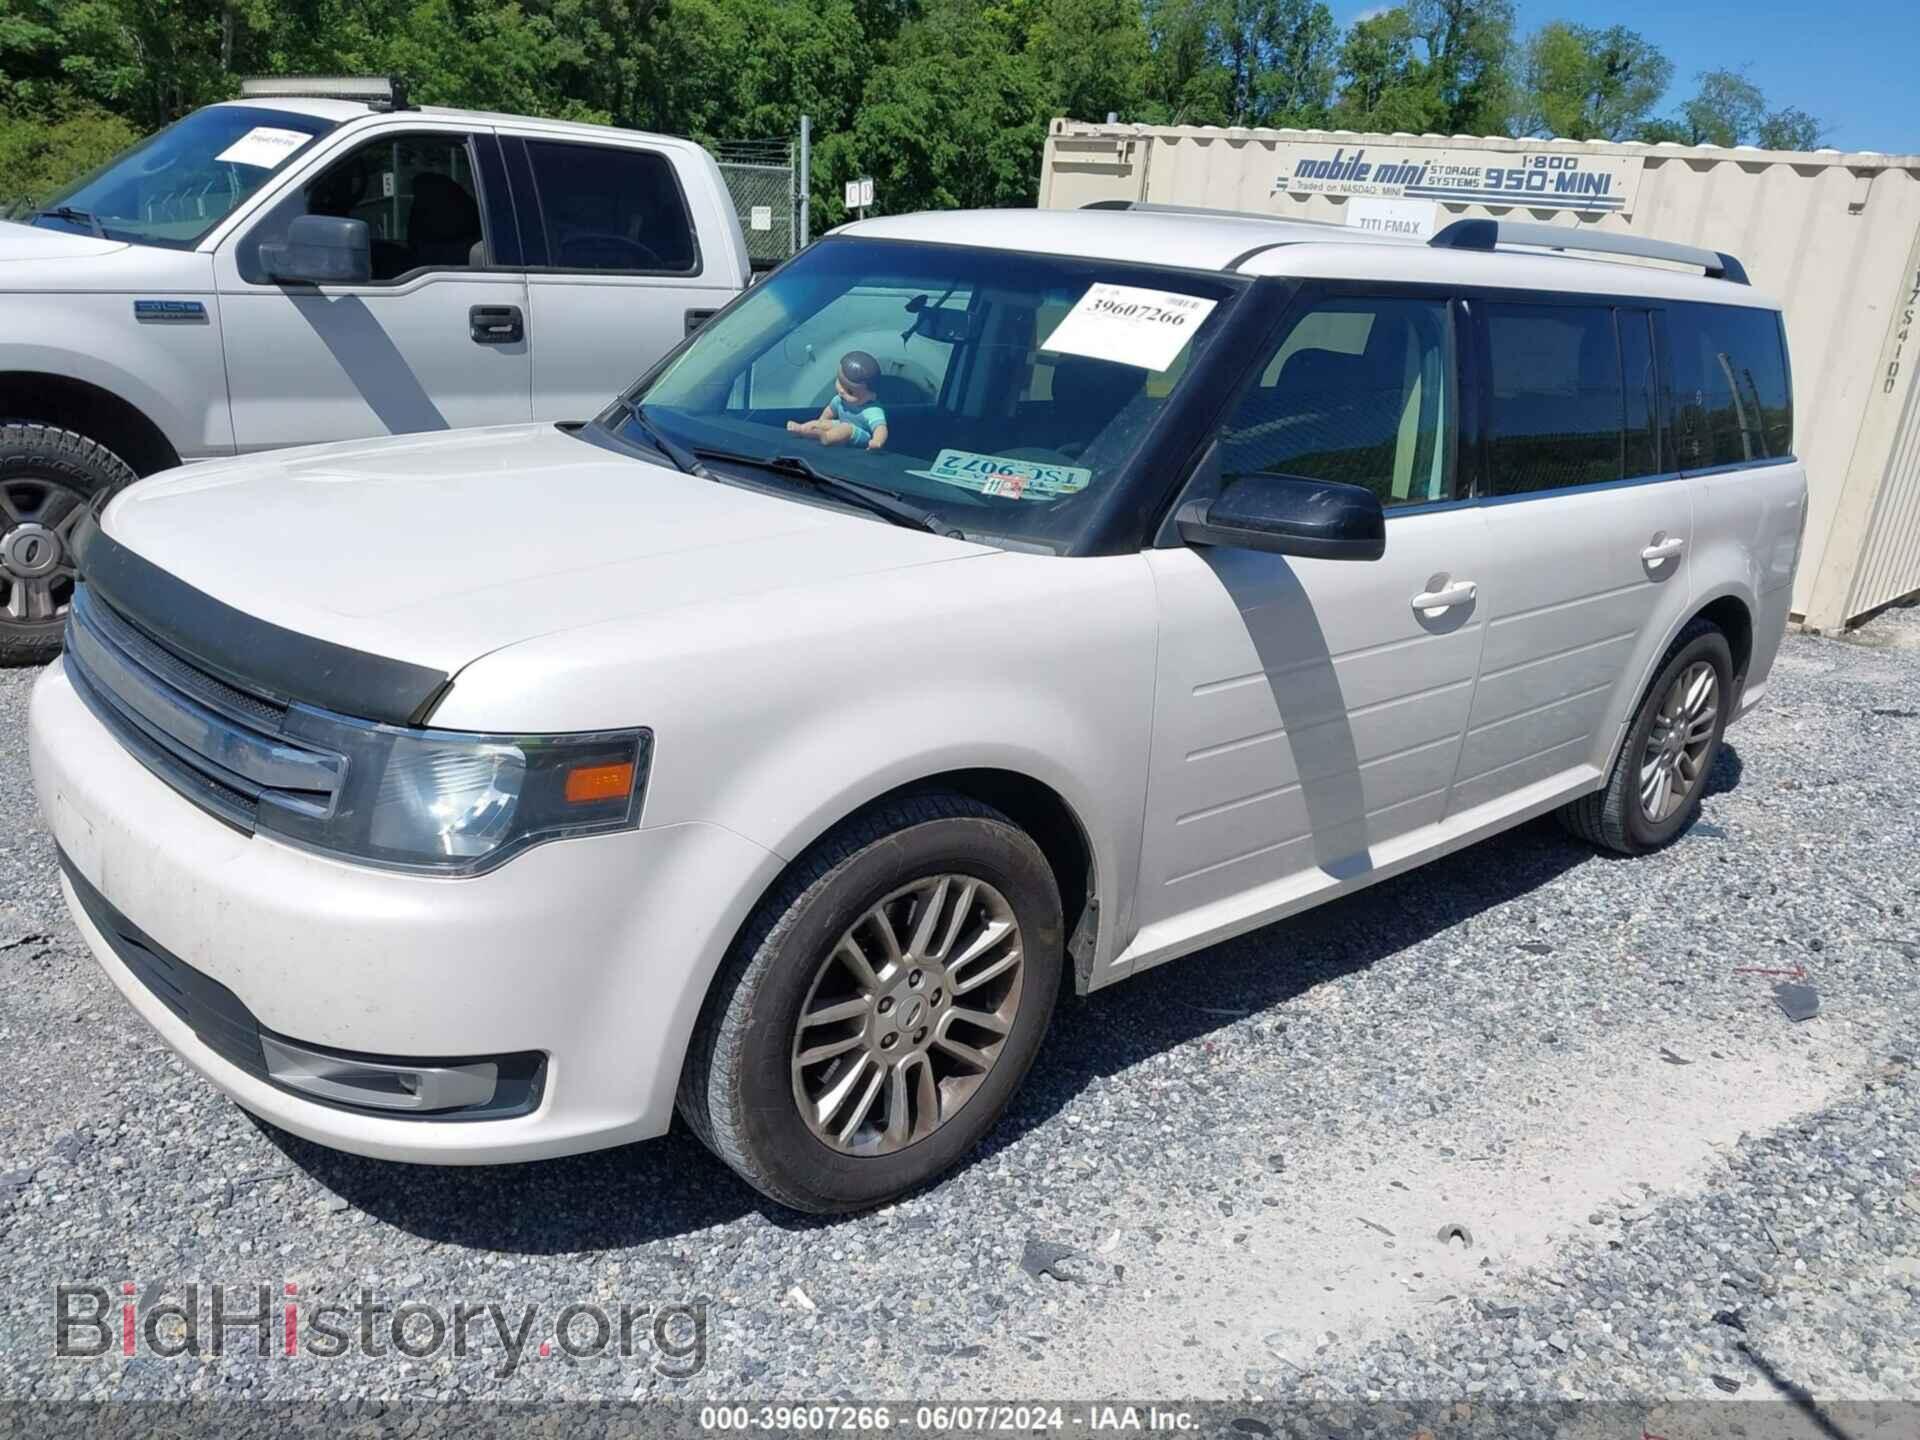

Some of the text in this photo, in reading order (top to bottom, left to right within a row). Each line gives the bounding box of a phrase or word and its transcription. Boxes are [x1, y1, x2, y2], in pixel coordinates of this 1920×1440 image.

[1294, 148, 1431, 185] mobile mini
[1430, 164, 1481, 176] STORAGE
[1428, 176, 1480, 188] SYSTEMS
[1484, 167, 1612, 195] 950-MINI
[1087, 299, 1185, 327] 39607266
